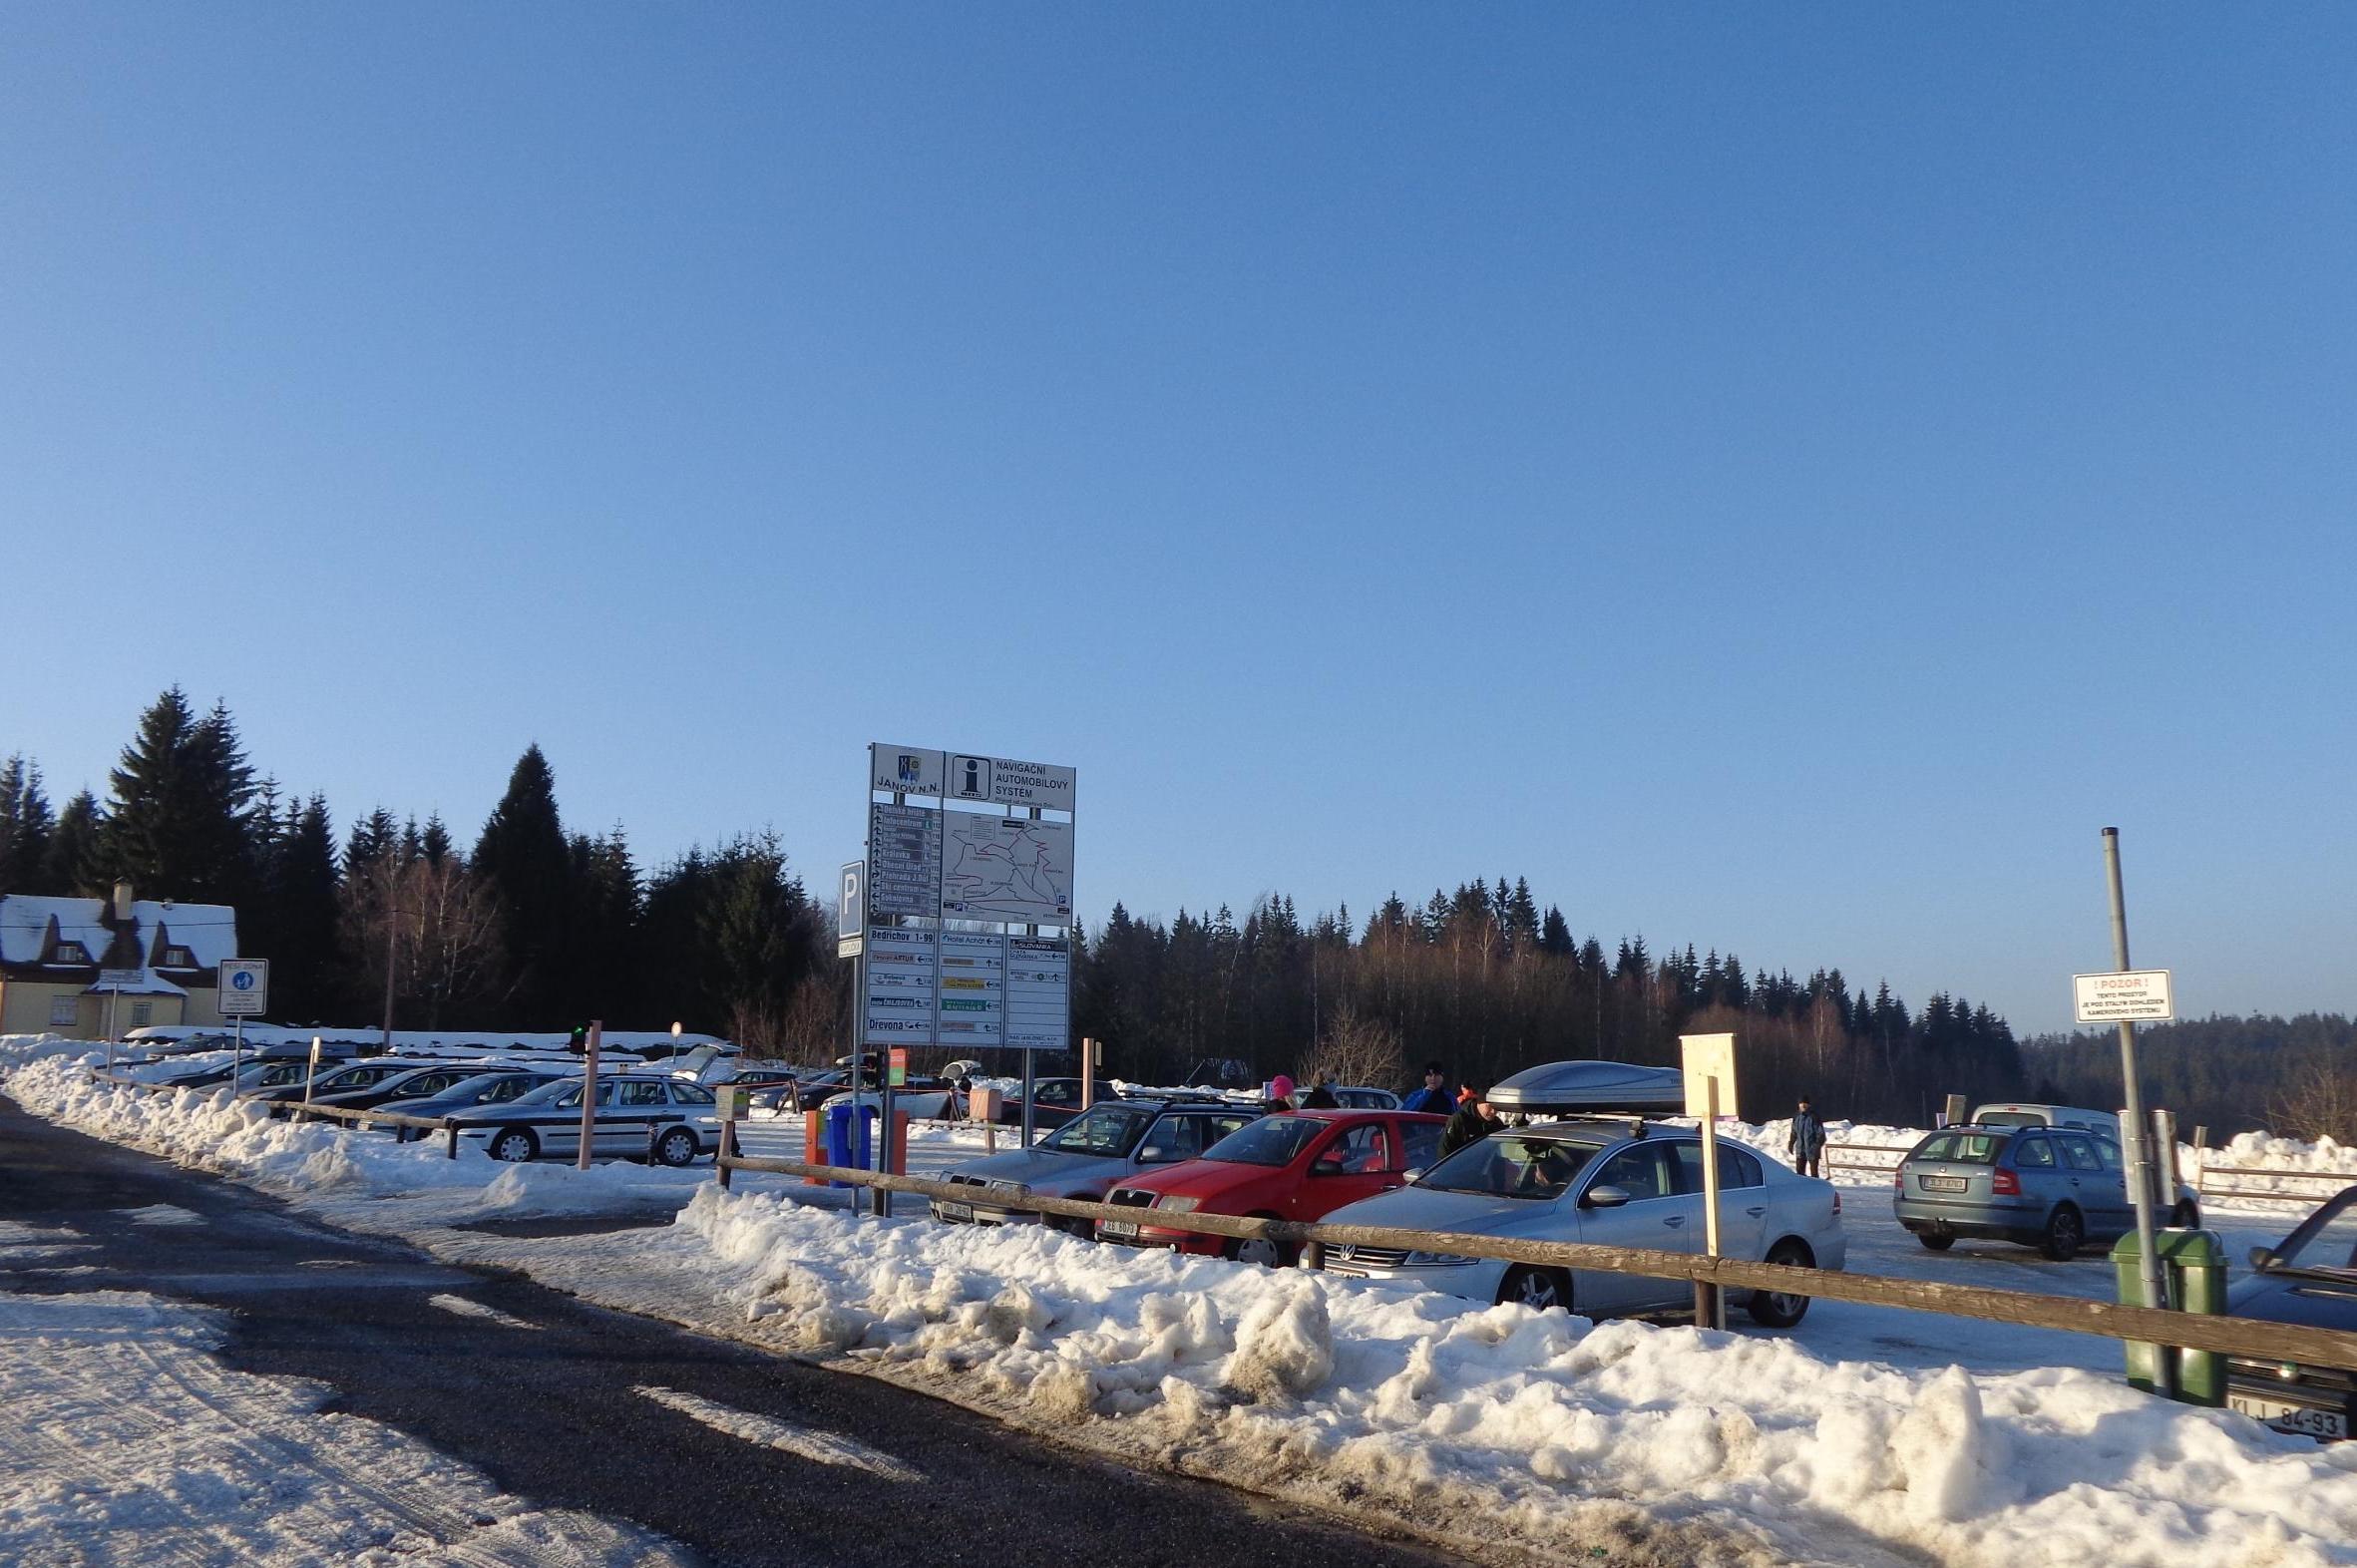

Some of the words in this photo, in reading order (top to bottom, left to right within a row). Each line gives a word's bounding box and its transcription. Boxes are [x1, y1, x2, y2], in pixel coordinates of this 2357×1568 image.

[878, 776, 916, 793] JANOV
[883, 815, 923, 828] Infocentrum
[915, 933, 934, 943] 1-99
[2101, 979, 2142, 989] POZOR
[869, 1018, 904, 1030] Drevona
[2281, 1406, 2338, 1434] 84-93
